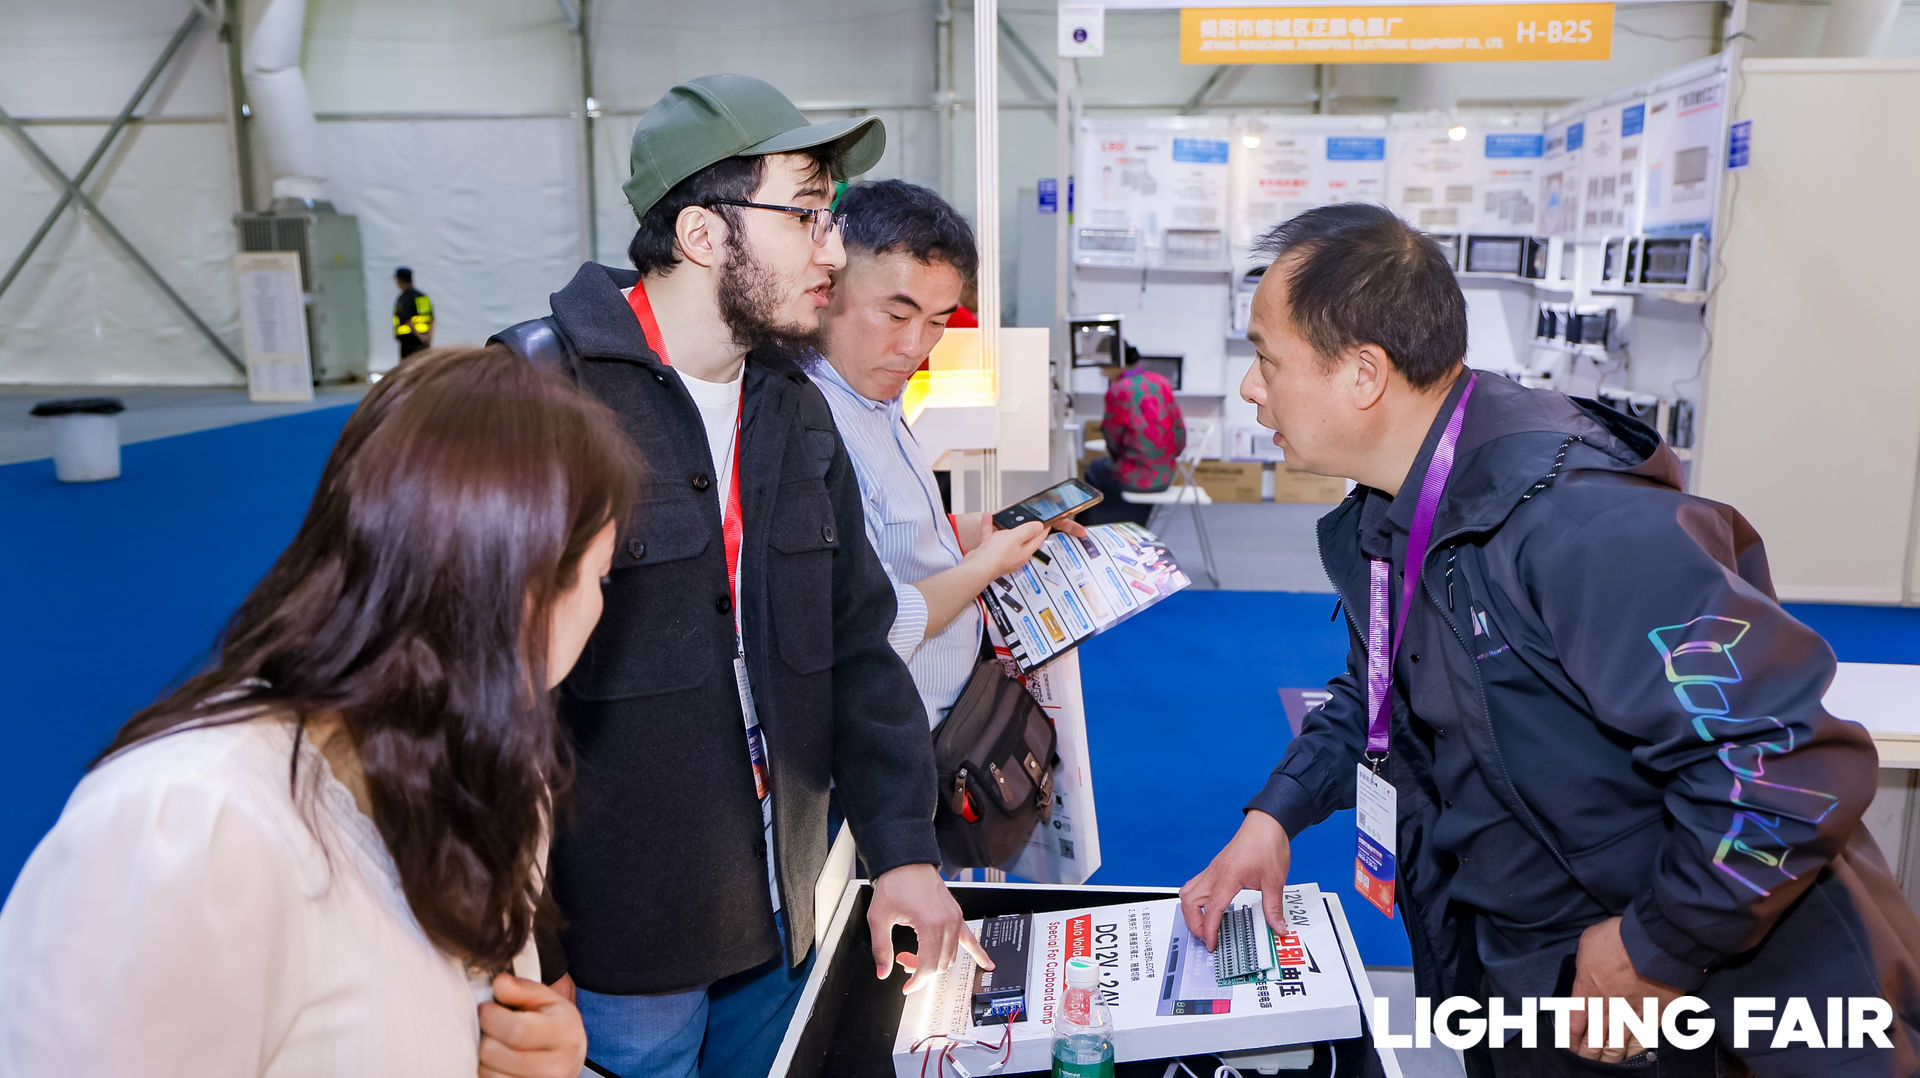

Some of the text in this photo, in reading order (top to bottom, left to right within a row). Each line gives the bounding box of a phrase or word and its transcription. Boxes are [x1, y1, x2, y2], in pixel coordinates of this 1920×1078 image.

[1516, 20, 1592, 43] H-B25
[1073, 919, 1085, 936] Auto
[1072, 936, 1085, 957] Volta
[1041, 921, 1060, 1025] Special For Cupboard lamp
[1274, 930, 1307, 998] 识别电压
